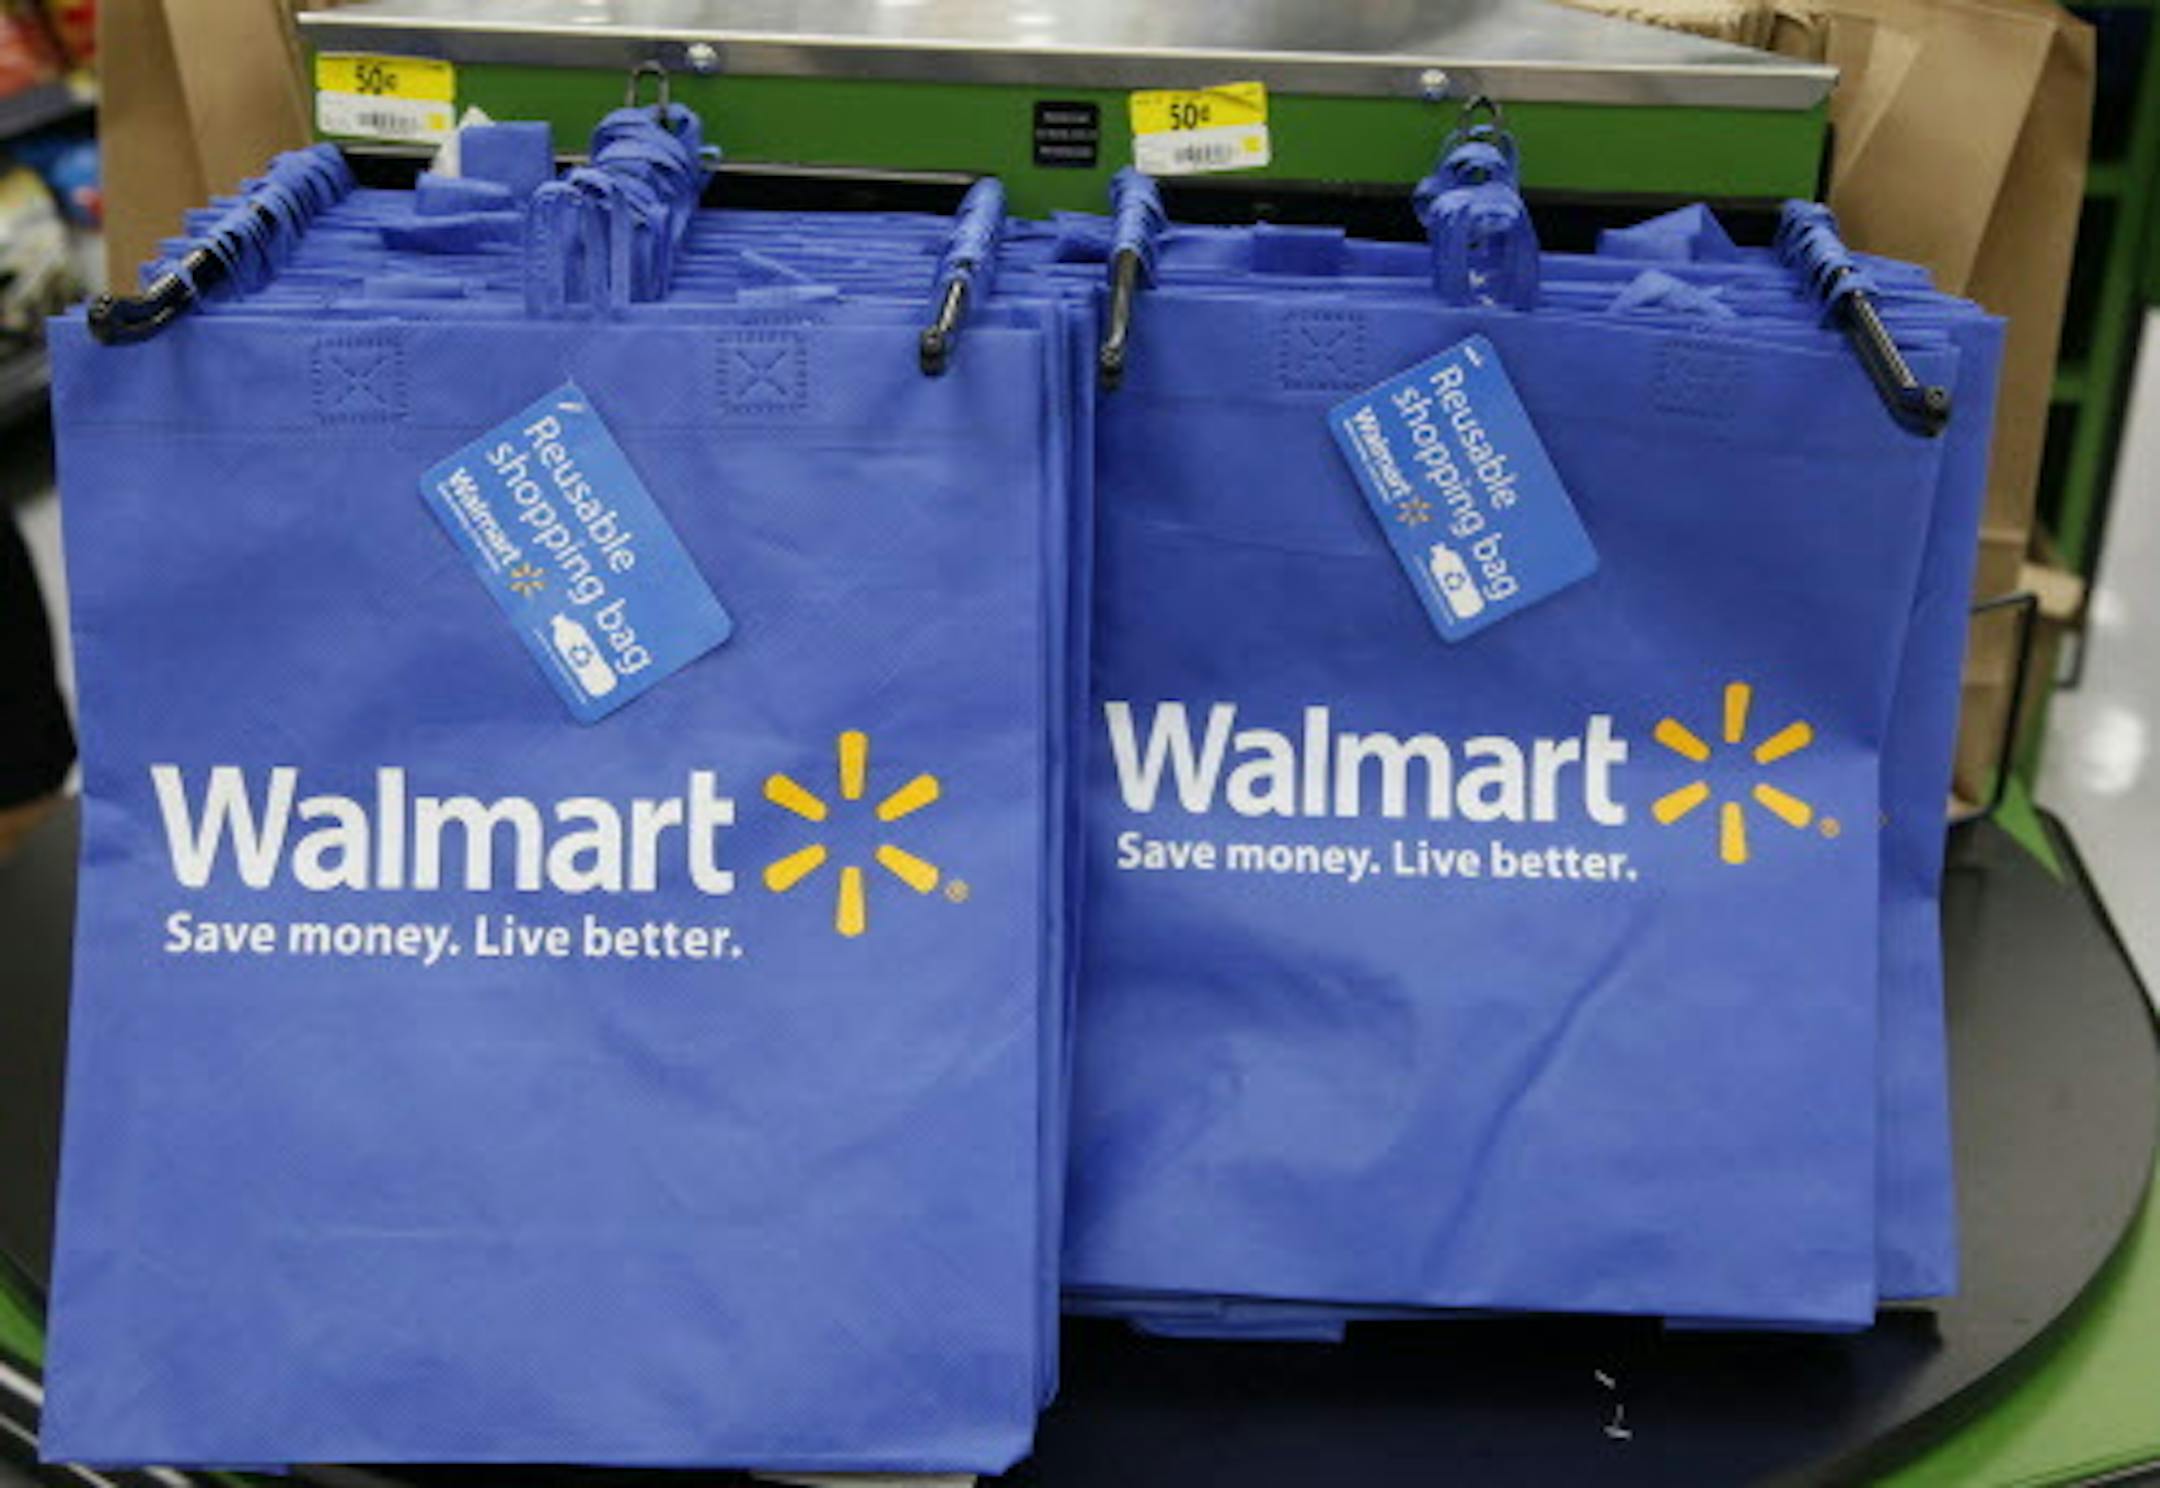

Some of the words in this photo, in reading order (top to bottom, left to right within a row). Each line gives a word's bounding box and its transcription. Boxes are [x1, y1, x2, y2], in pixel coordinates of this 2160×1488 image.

[524, 414, 636, 574] Reusable
[1354, 404, 1413, 499] Walmart
[1391, 387, 1485, 538] shopping
[1473, 531, 1520, 602] bag
[1430, 364, 1519, 509] Reusable
[449, 467, 522, 566] Walmart
[486, 441, 605, 605] shopping
[596, 597, 652, 675] bag
[1104, 702, 1627, 826] Walmart
[151, 765, 735, 895] Walmart
[1117, 831, 1217, 871] Save
[1226, 843, 1382, 884] money.
[1392, 839, 1481, 879] Live
[1490, 841, 1638, 882] better.
[164, 910, 277, 954] Save
[288, 921, 461, 967] money.
[474, 913, 571, 957] Live
[583, 913, 743, 959] better.
